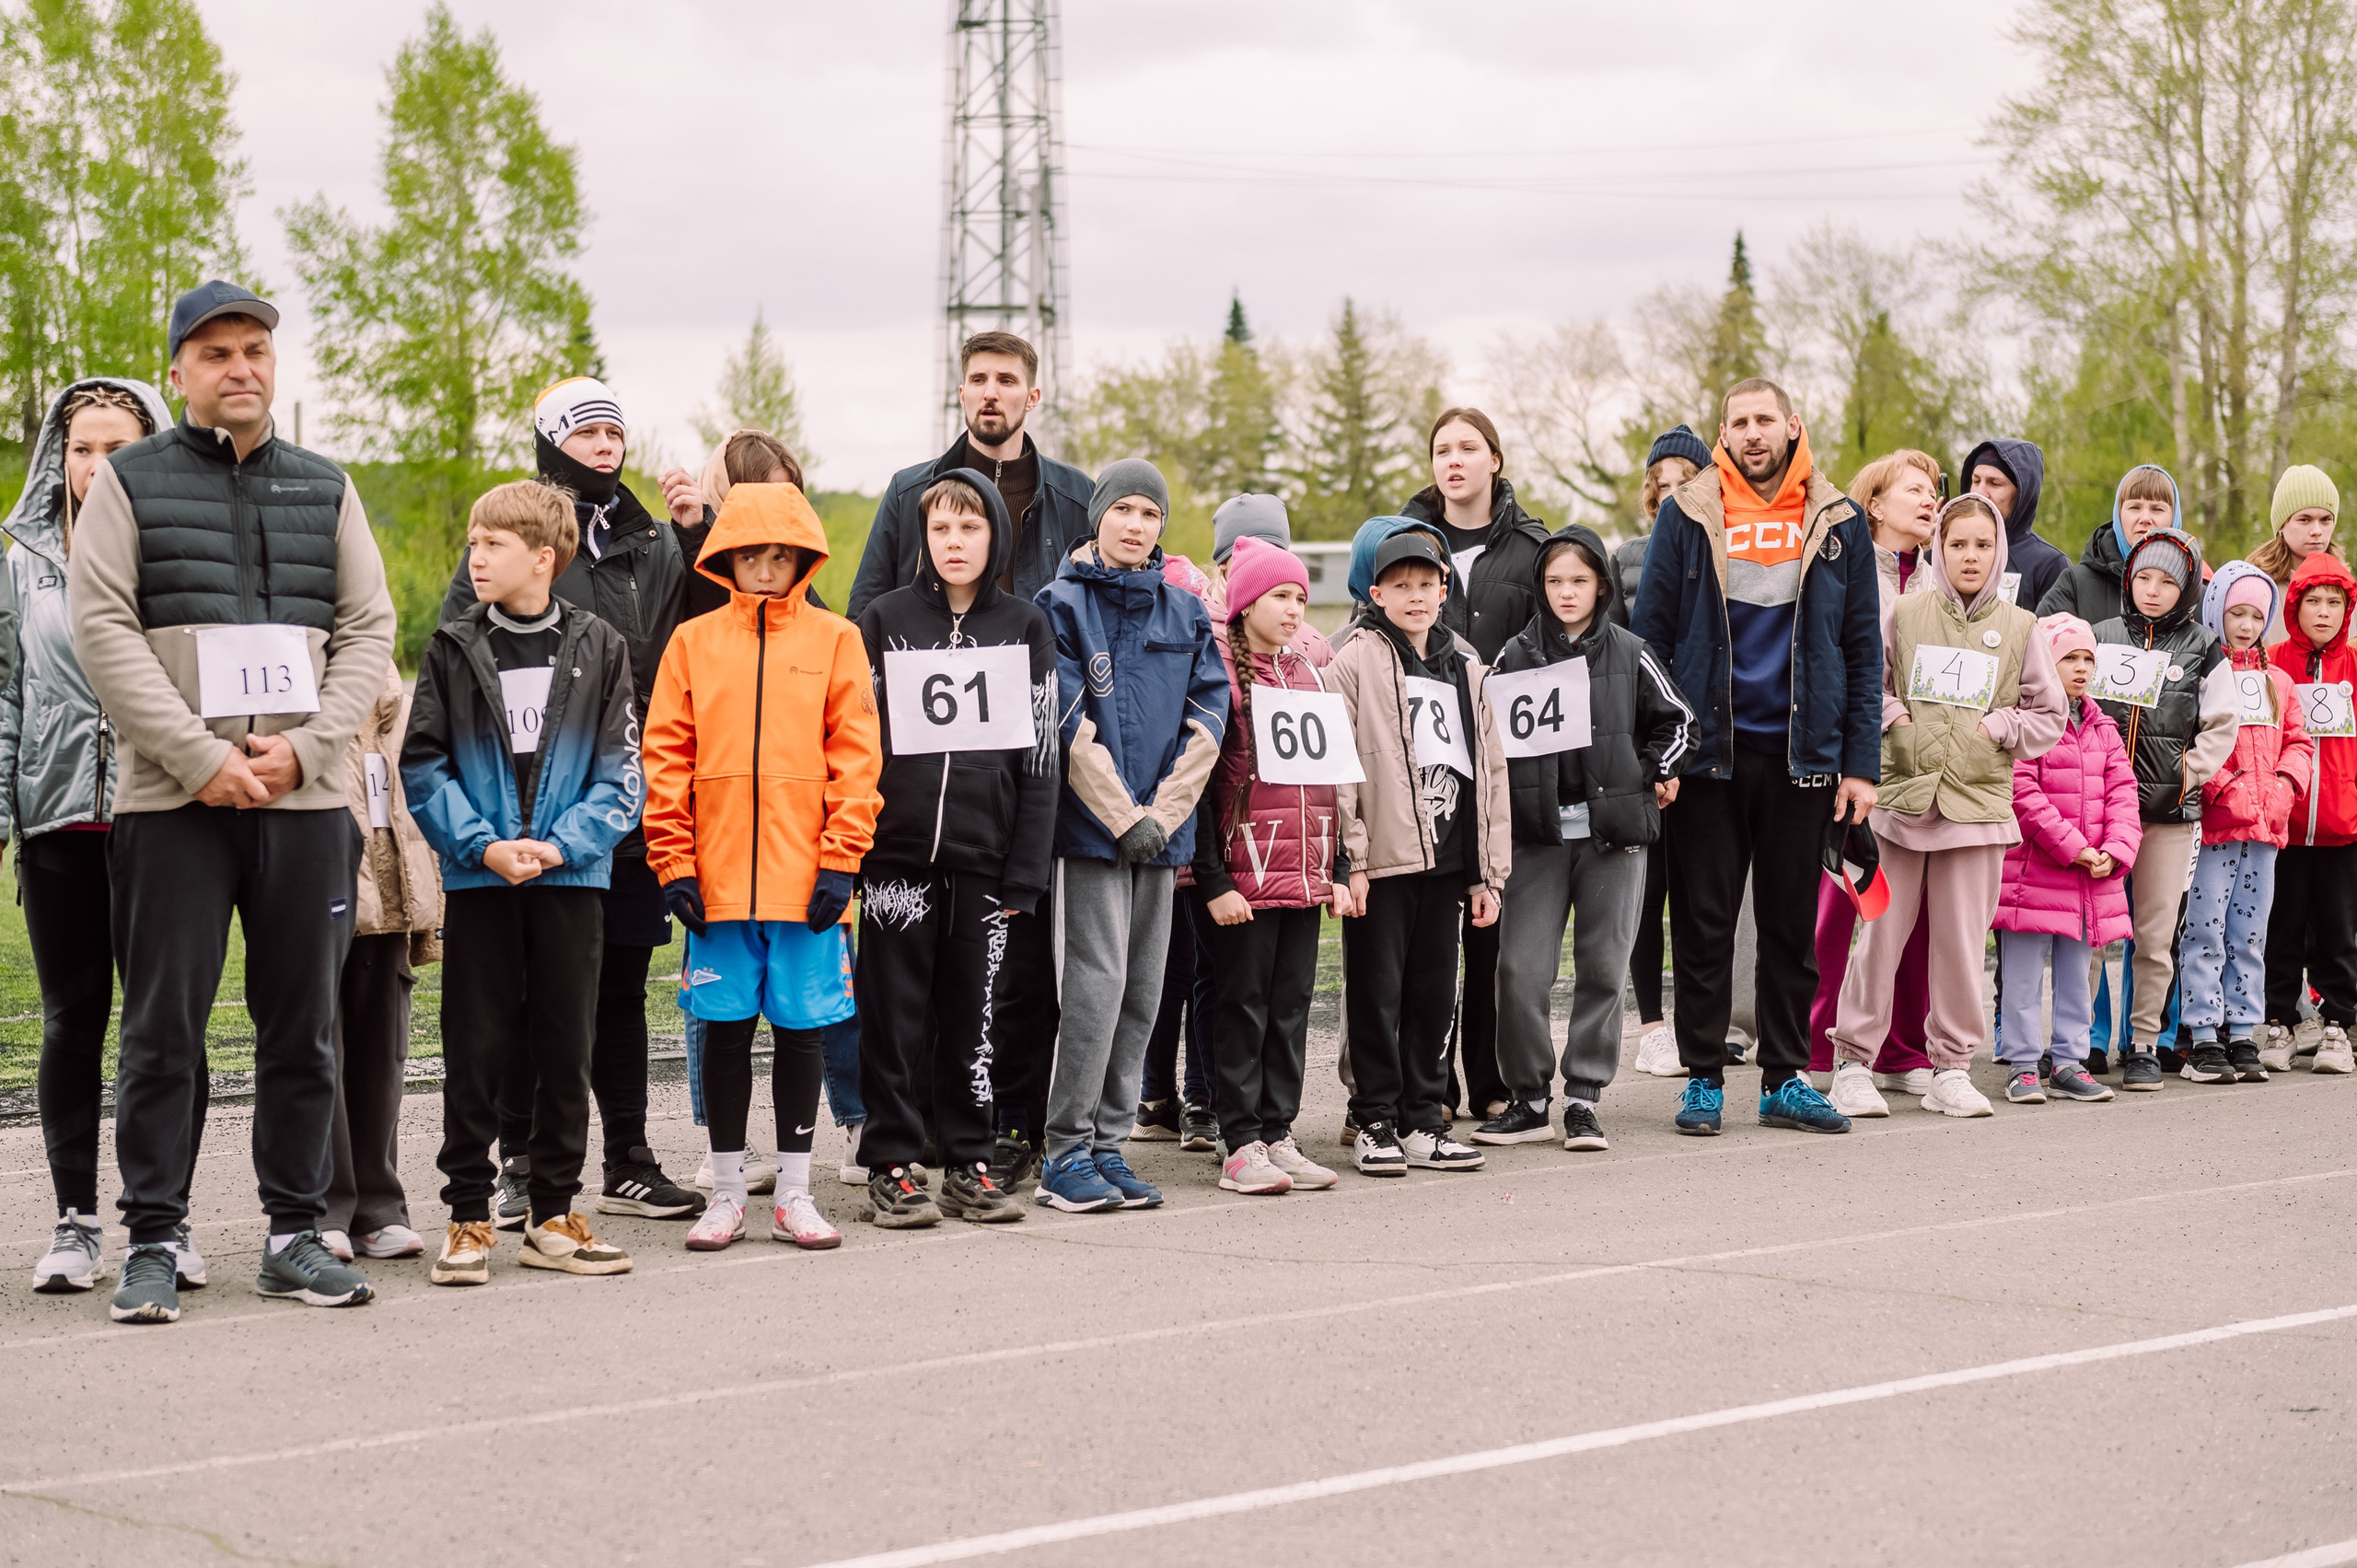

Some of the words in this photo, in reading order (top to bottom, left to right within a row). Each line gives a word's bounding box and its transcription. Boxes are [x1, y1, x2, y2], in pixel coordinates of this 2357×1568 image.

[239, 665, 293, 695] 113
[1941, 652, 1963, 691] 4
[2110, 653, 2138, 686] 3
[922, 670, 990, 726] 61
[2240, 676, 2262, 711] 9
[2310, 687, 2333, 725] 8
[1409, 696, 1452, 745] 78
[1510, 687, 1565, 740] 64
[1271, 711, 1327, 761] 60
[1798, 773, 1832, 788] CCM
